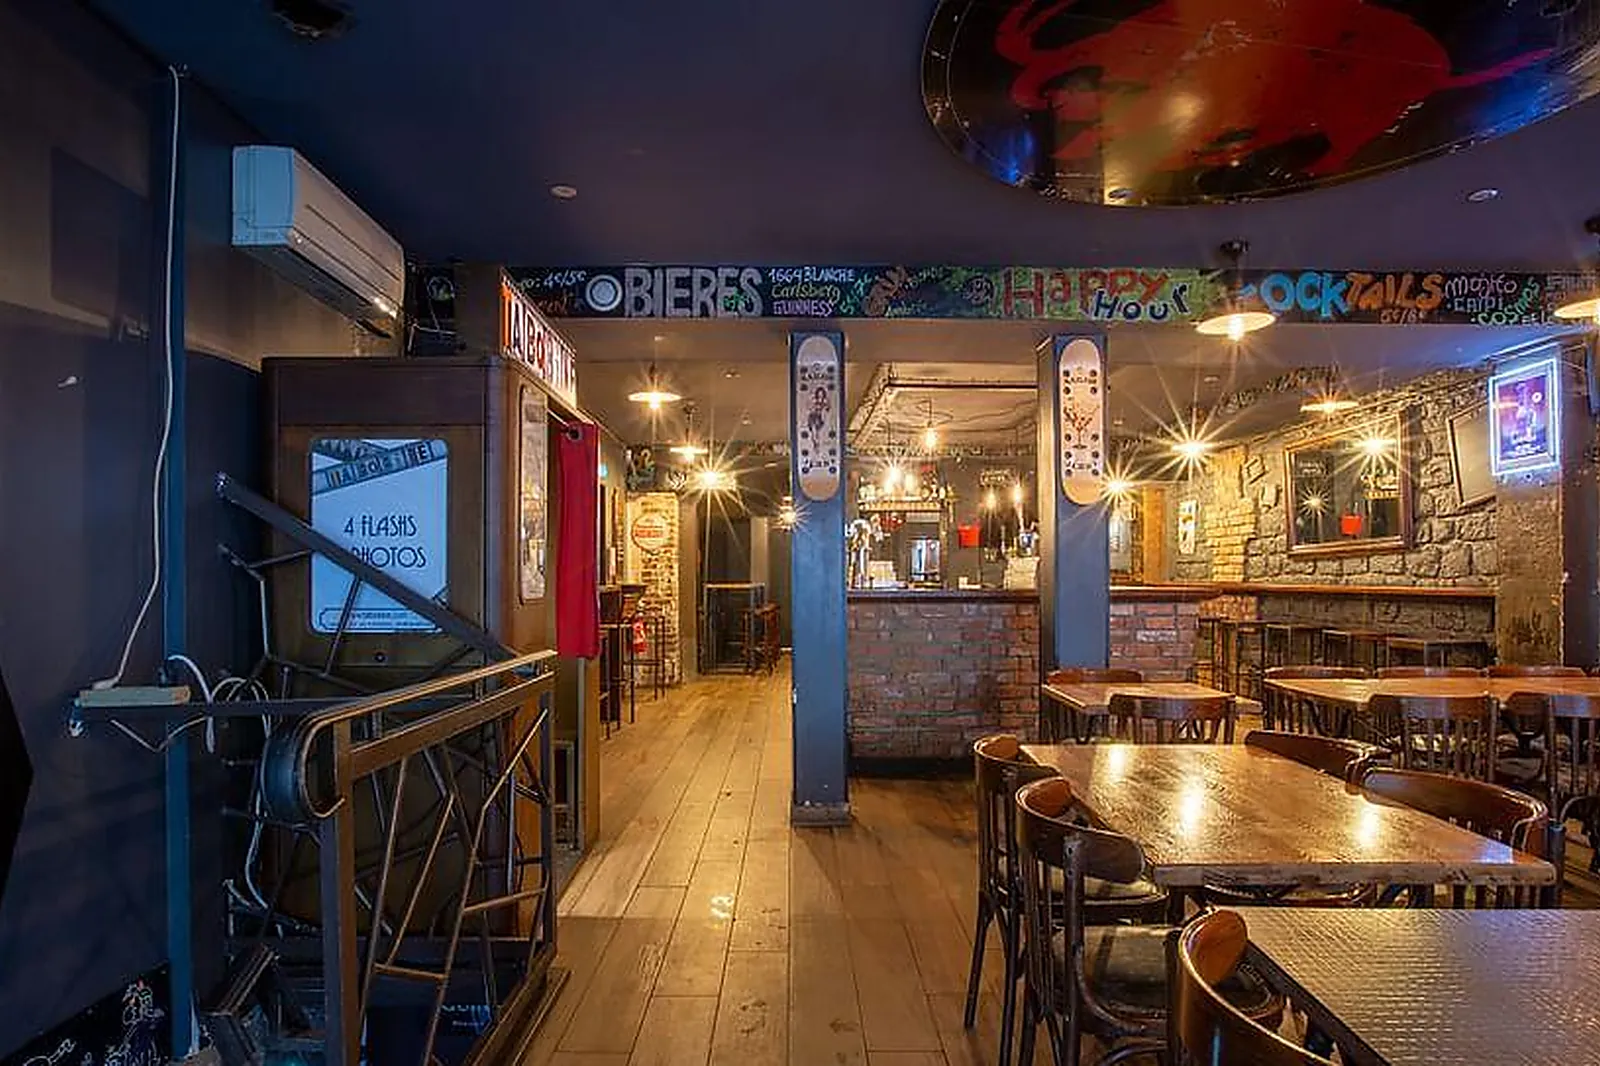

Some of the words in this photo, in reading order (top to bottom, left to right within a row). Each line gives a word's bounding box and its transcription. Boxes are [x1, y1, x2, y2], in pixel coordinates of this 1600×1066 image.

[622, 267, 763, 318] BIERES
[773, 300, 833, 317] GUINNESS
[343, 517, 354, 536] 4
[362, 515, 417, 537] FLASHS
